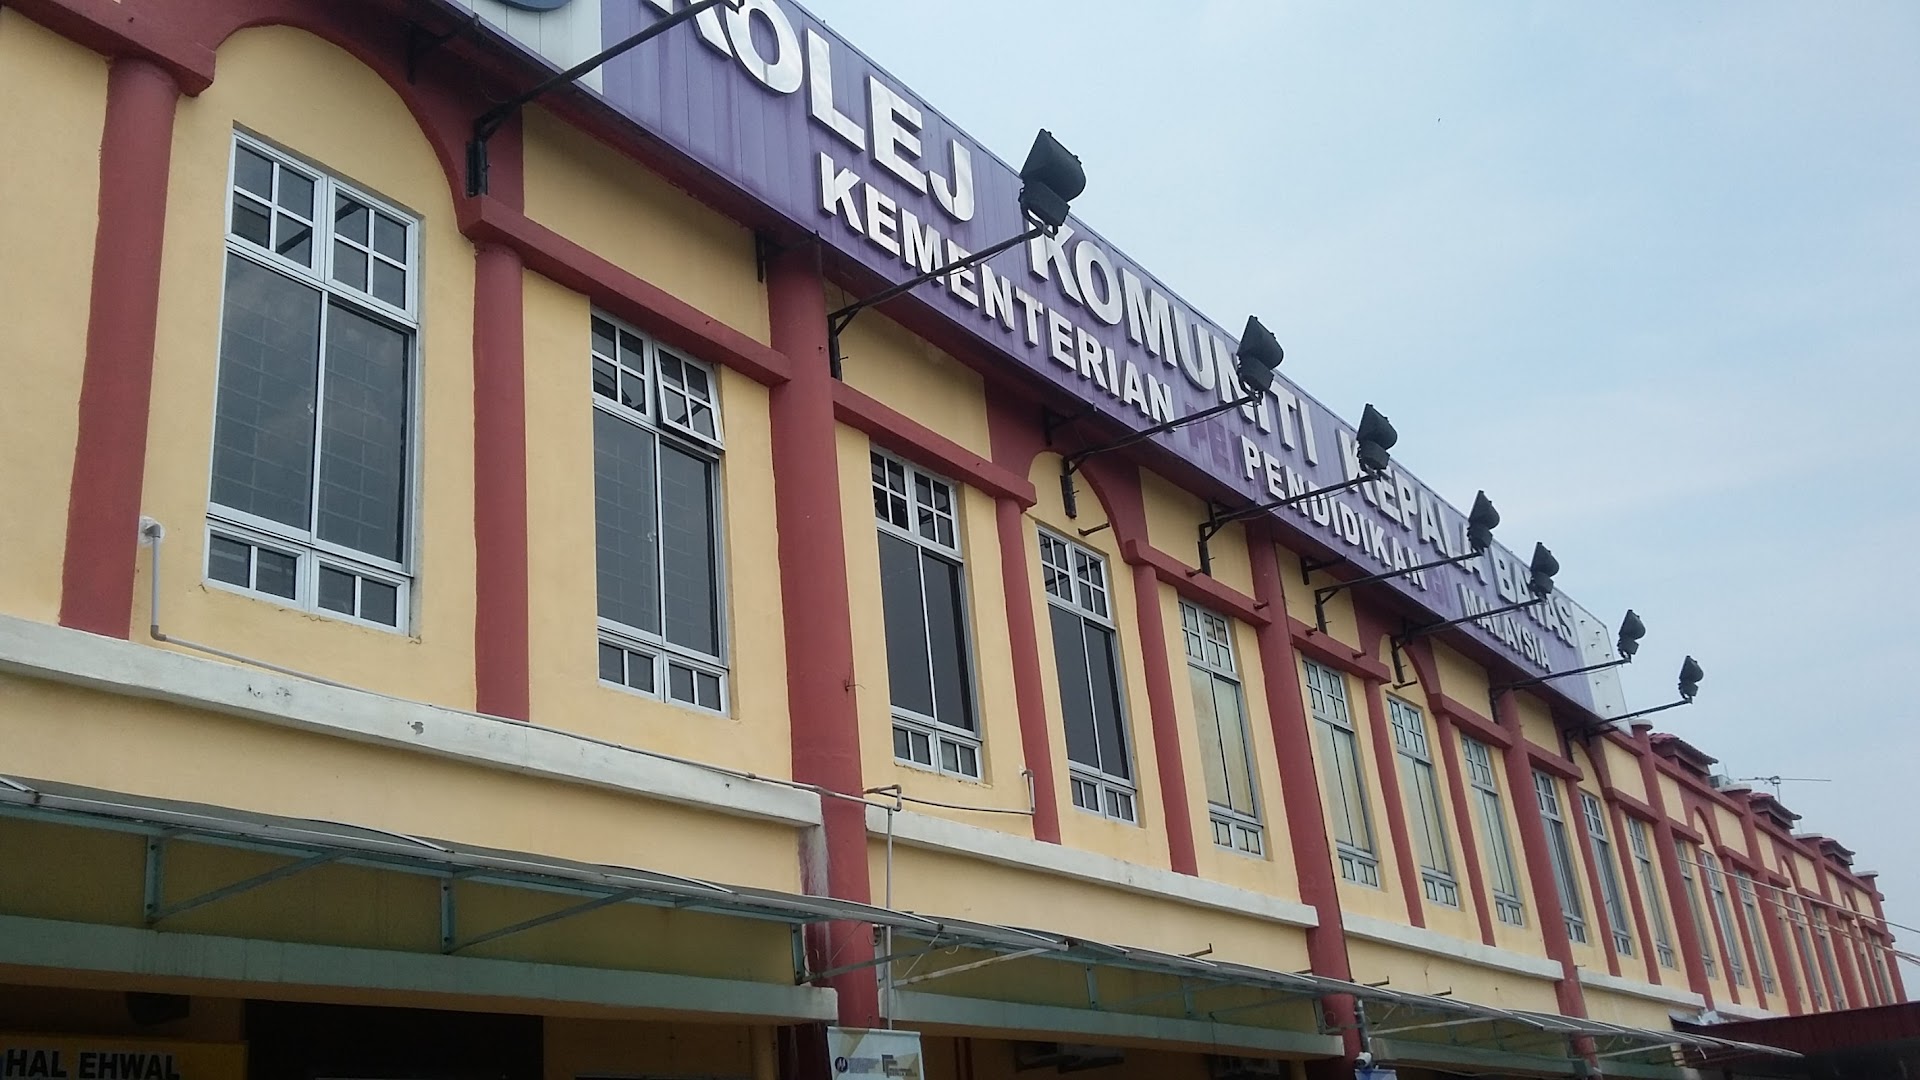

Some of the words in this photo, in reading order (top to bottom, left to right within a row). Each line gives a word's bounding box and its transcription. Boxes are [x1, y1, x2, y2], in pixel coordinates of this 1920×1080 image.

[820, 151, 1176, 432] KEMENTERIAN
[1240, 434, 1428, 592] PENDIDIKAN
[1458, 583, 1551, 672] MALAYSIA
[6, 1049, 67, 1078] HAL
[79, 1052, 180, 1080] EHWAL
